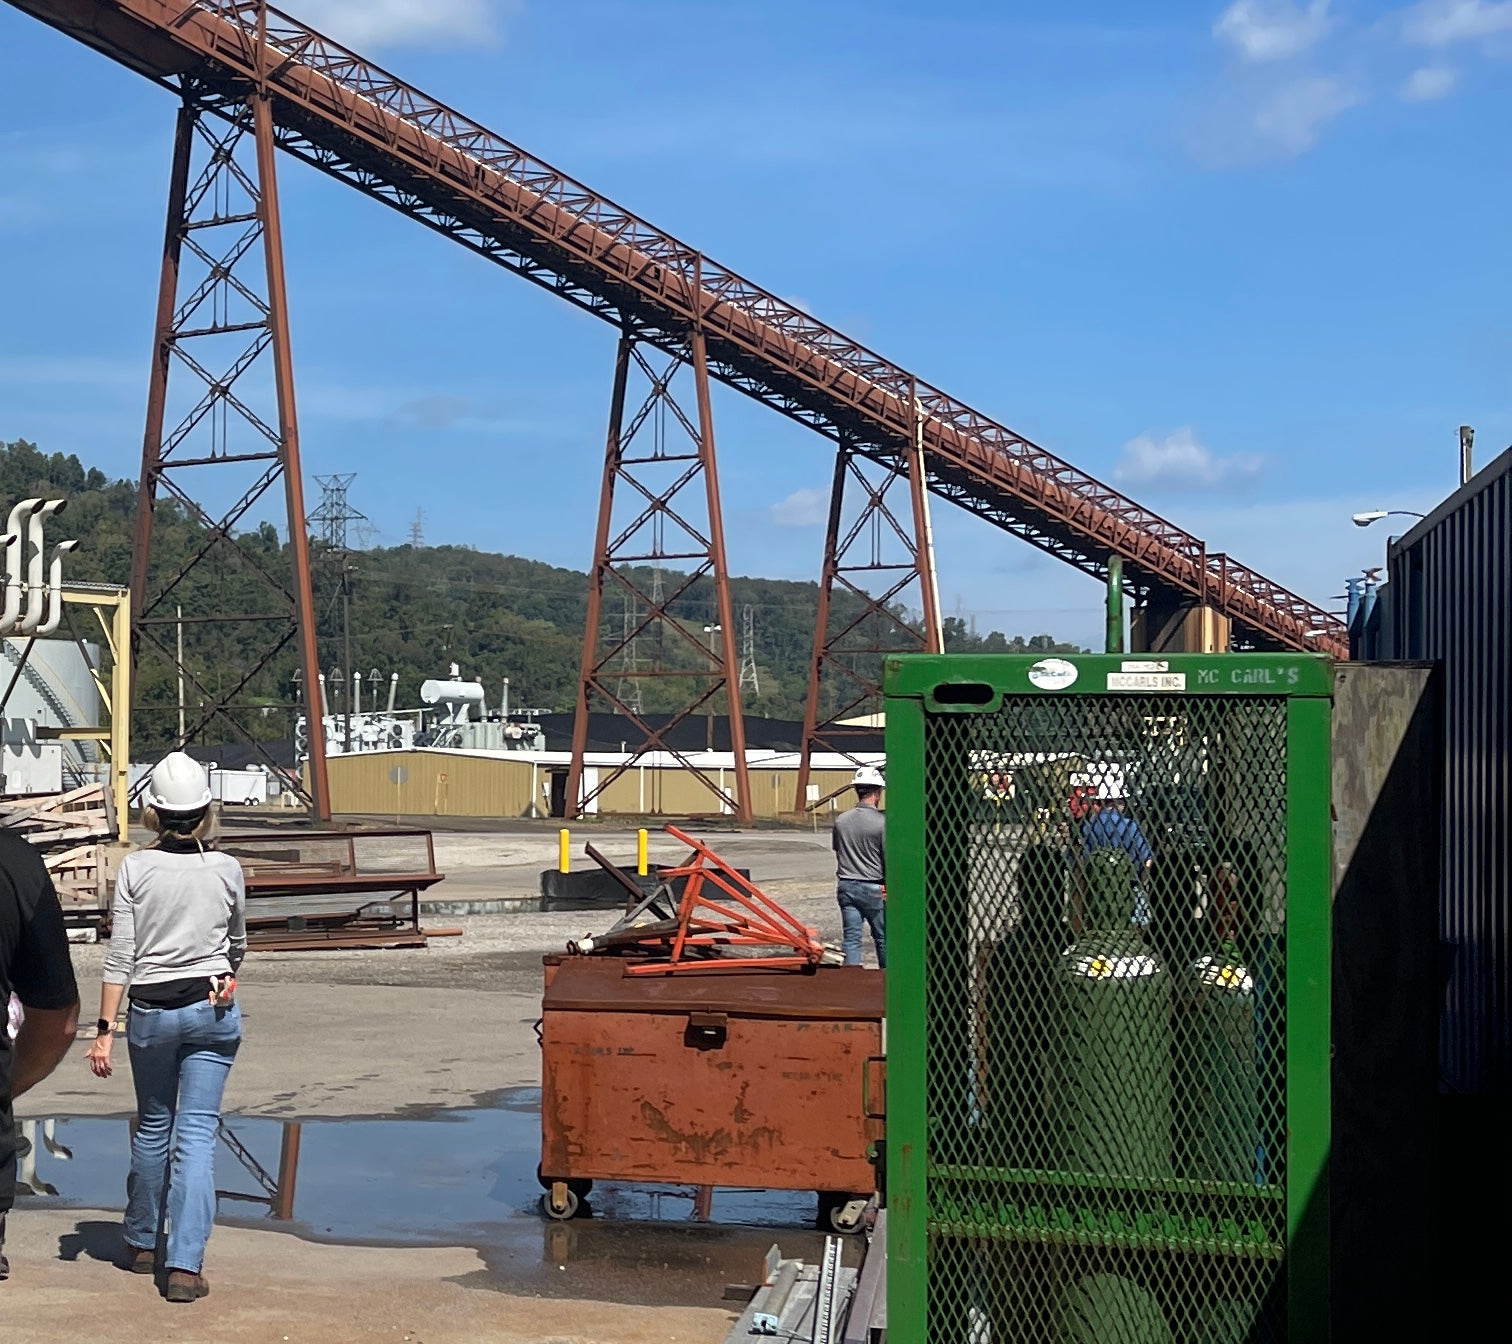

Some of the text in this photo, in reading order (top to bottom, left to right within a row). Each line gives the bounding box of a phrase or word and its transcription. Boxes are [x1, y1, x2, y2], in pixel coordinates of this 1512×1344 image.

[1111, 676, 1181, 687] MCCARLS INC.
[1197, 668, 1299, 684] MC CARL'S
